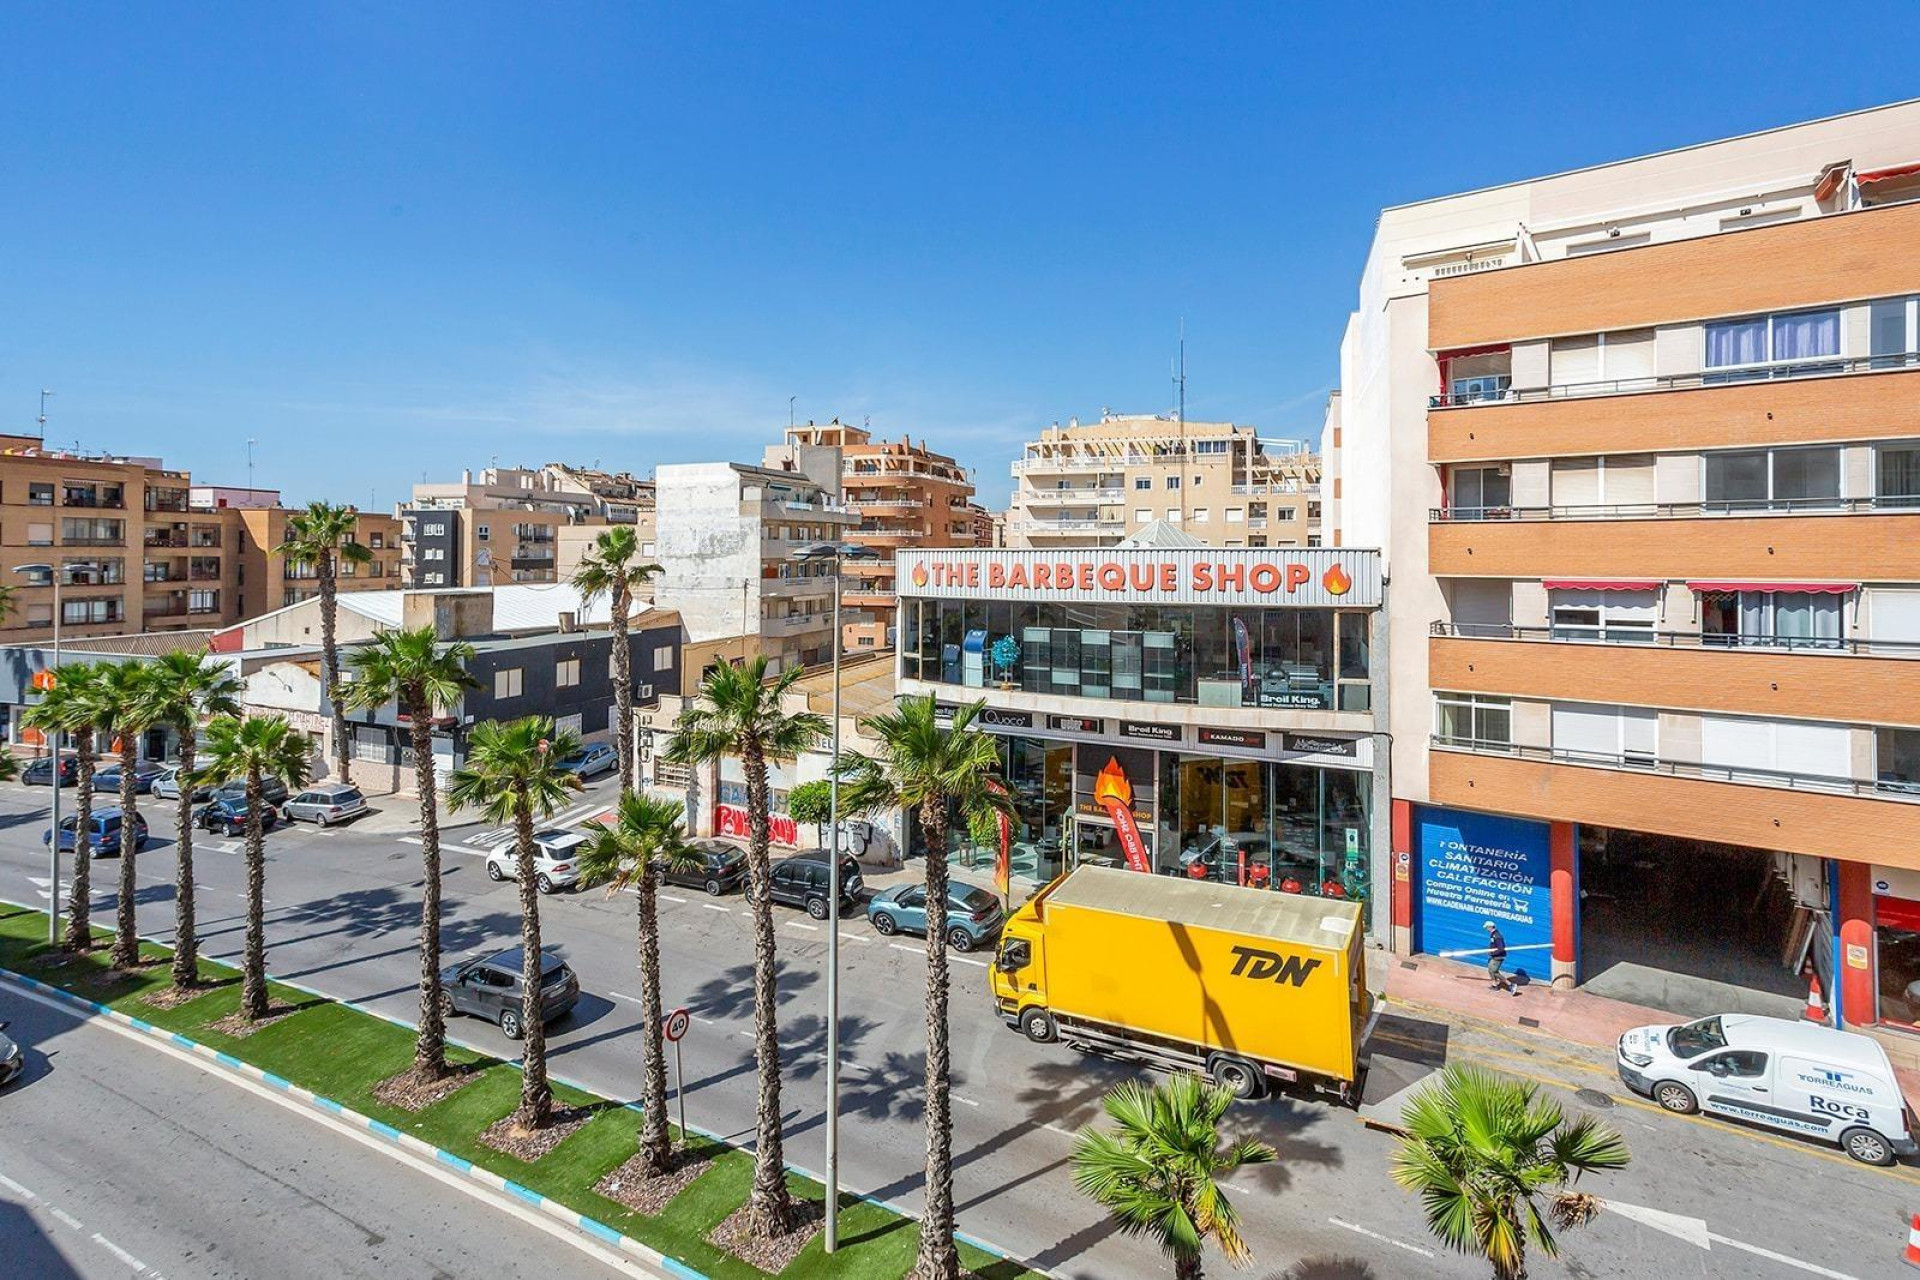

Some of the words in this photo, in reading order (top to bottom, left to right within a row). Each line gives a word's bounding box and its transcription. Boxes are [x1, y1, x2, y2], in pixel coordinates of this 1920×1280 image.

[932, 562, 979, 588] THE
[988, 563, 1177, 592] BARBEQUE
[1192, 562, 1310, 593] SHOP
[1260, 694, 1290, 703] Broil
[1291, 695, 1320, 705] King
[1127, 724, 1151, 734] Broil
[1151, 726, 1173, 736] King
[1210, 733, 1244, 742] KAMADO
[1428, 859, 1534, 884] CLIMATIZACIÓN
[1444, 851, 1518, 871] SANITARIO
[1436, 870, 1533, 895] CALEFACCIÓN
[1464, 885, 1496, 898] Online
[1230, 945, 1322, 988] TDN
[672, 1018, 685, 1033] 40
[1798, 1073, 1874, 1095] TORREAGUAS
[1809, 1094, 1870, 1119] Roca
[1710, 1102, 1829, 1134] www.torreaguas.com
